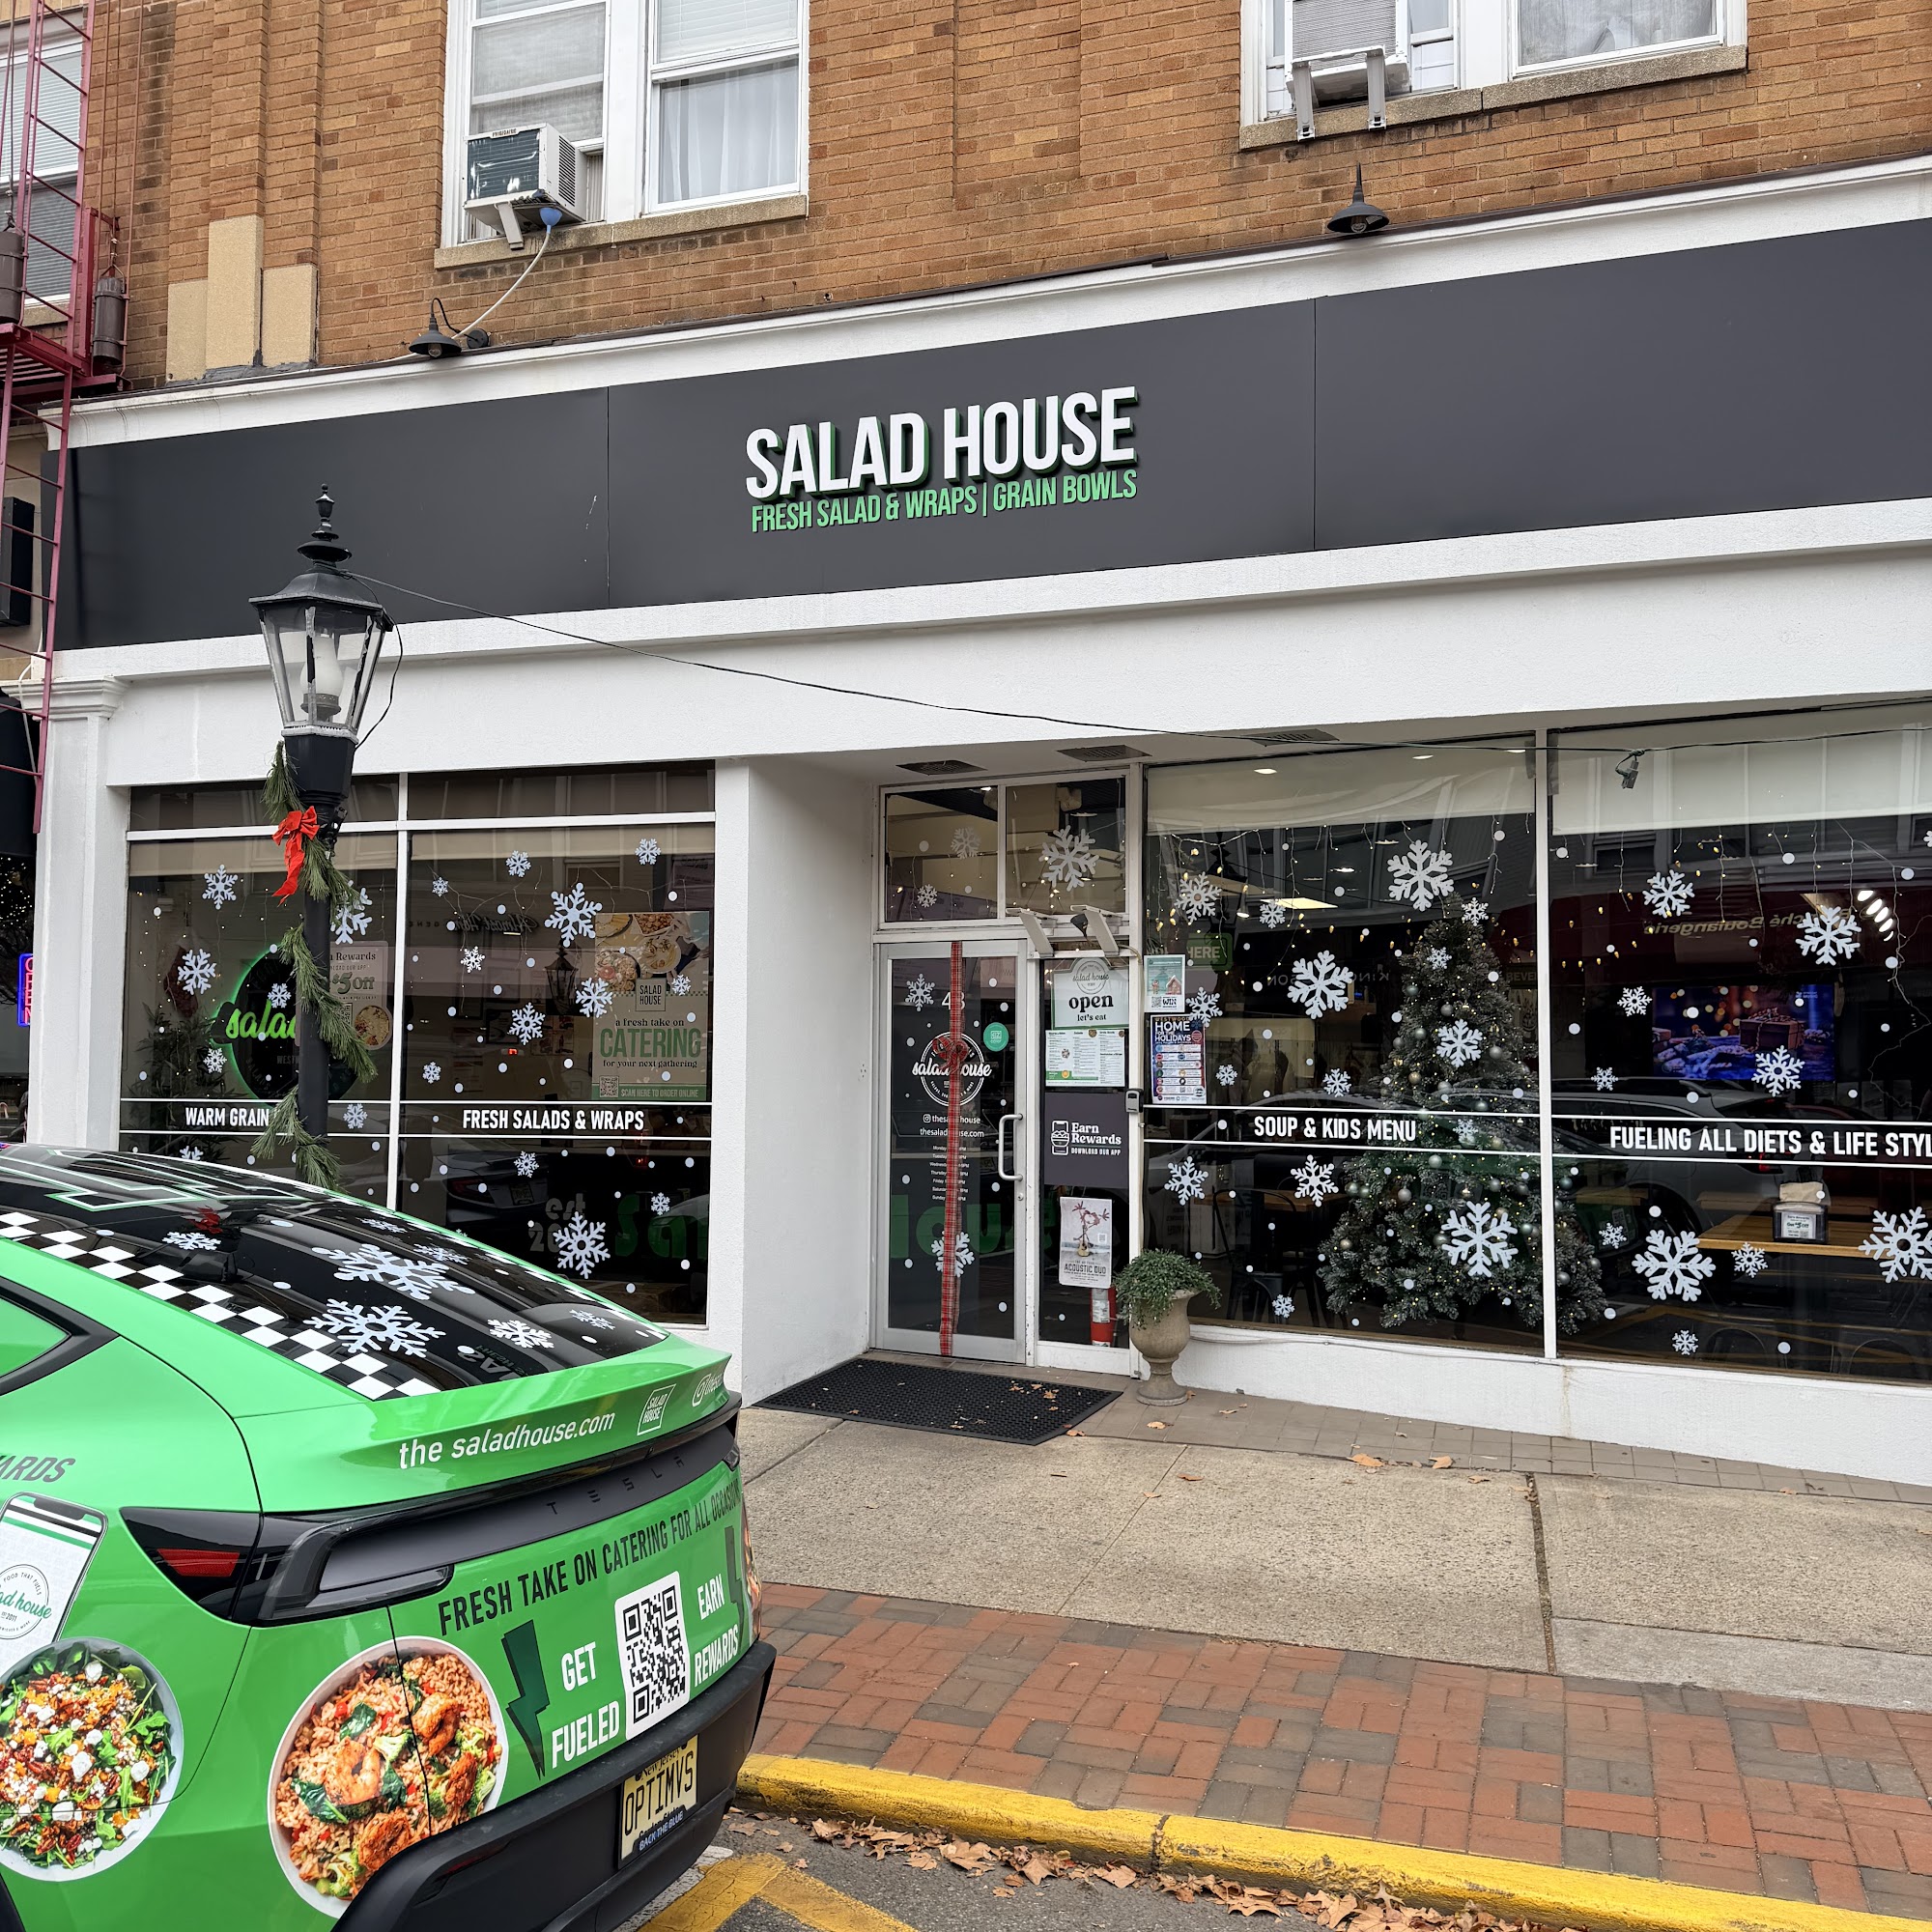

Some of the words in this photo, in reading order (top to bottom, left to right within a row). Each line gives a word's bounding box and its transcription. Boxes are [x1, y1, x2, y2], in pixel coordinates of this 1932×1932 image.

[746, 412, 928, 499] SALAD
[944, 386, 1138, 482] HOUSE
[752, 500, 812, 532] FRESH
[816, 492, 882, 527] SALAD
[885, 493, 899, 521] &
[905, 487, 978, 519] WRAPS
[993, 476, 1058, 512] GRAIN
[1063, 469, 1138, 503] BOWLS
[335, 952, 376, 960] Rewards
[1072, 972, 1091, 981] salad
[1092, 972, 1110, 980] house
[639, 985, 662, 995] SALAD
[639, 996, 661, 1005] HOUSE
[1068, 995, 1114, 1012] open
[1154, 1021, 1191, 1032] HOME
[600, 1028, 701, 1058] CATERING
[1154, 1034, 1192, 1042] HOLIDAYS
[658, 1060, 697, 1068] gathering
[960, 1063, 992, 1077] ouse
[620, 1089, 636, 1097] SCAN
[637, 1089, 650, 1097] HERE
[651, 1089, 659, 1097] TO
[660, 1089, 677, 1097] ORDER
[678, 1089, 698, 1097] ONLINE
[185, 1107, 225, 1126] WARM
[230, 1108, 270, 1126] GRAIN
[463, 1109, 508, 1129] FRESH
[513, 1110, 570, 1130] SALADS
[574, 1110, 586, 1129] &
[590, 1111, 644, 1131] WRAPS
[1071, 1122, 1099, 1133] Earn
[1254, 1116, 1298, 1137] SOUP
[1303, 1118, 1317, 1138] &
[1321, 1118, 1361, 1139] KIDS
[1367, 1120, 1416, 1142] MENU
[1071, 1133, 1122, 1145] Rewards
[1610, 1125, 1691, 1151] FUELING
[1699, 1128, 1737, 1152] ALL
[1745, 1130, 1802, 1154] DIETS
[1809, 1131, 1826, 1154] &
[1833, 1131, 1878, 1155] LIFE
[1886, 1133, 1932, 1157] STYL
[1065, 1264, 1093, 1273] ACOUSTIC
[1094, 1265, 1107, 1274] DUO
[647, 1394, 668, 1409] SALAD
[642, 1406, 662, 1424] HOUSE
[398, 1438, 442, 1470] the
[451, 1408, 615, 1461] saladhouse.com
[547, 1456, 685, 1516] TESLA
[438, 1577, 513, 1636] FRESH
[518, 1561, 568, 1607] TAKE
[574, 1548, 598, 1585] ON
[602, 1520, 668, 1575] CATERING
[670, 1510, 692, 1545] FOR
[695, 1499, 711, 1533] ALL
[14, 1592, 52, 1619] house
[696, 1574, 724, 1620] EARN
[6, 1612, 17, 1622] 2011
[694, 1624, 740, 1688] REWARDS
[560, 1641, 596, 1691] GET
[552, 1700, 620, 1769] FUELED
[639, 1831, 657, 1851] BACK
[657, 1821, 668, 1838] THE
[668, 1810, 684, 1829] BLUE
